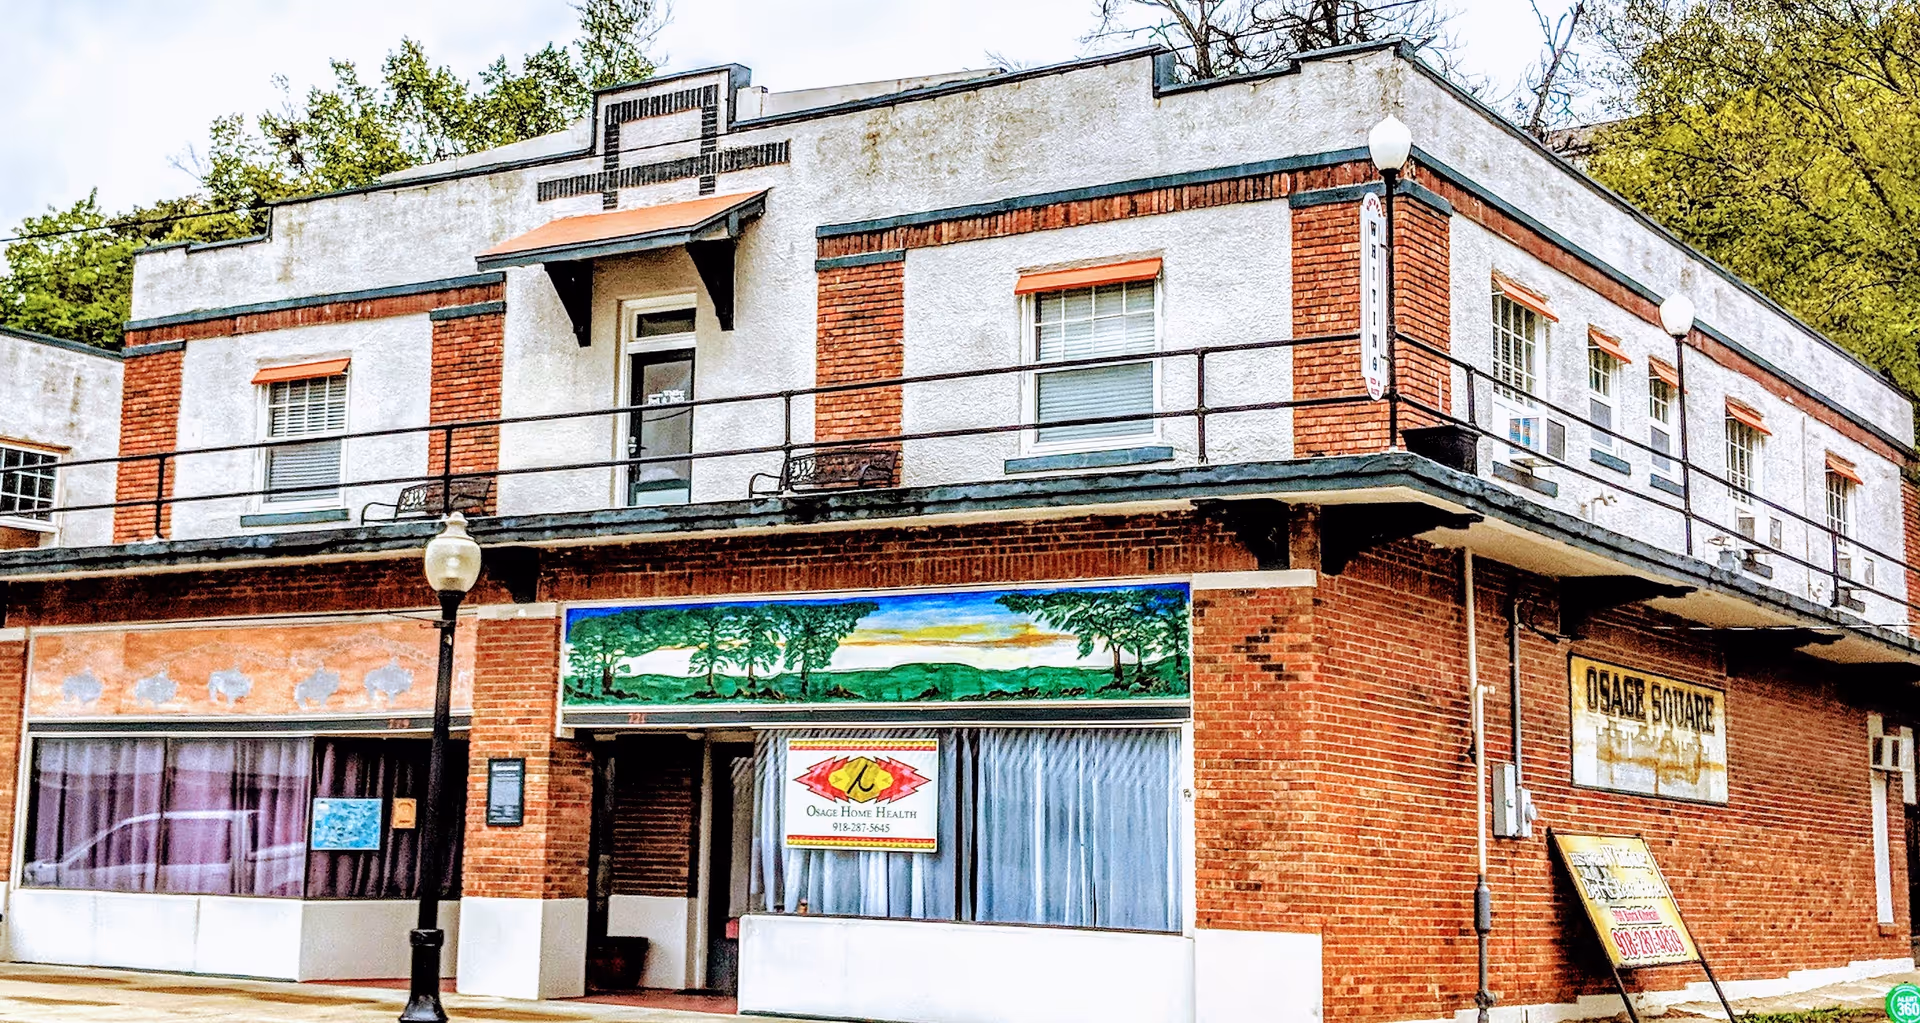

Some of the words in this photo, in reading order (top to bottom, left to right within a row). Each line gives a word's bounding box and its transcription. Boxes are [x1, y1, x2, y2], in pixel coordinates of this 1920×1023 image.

[1586, 666, 1646, 722] OSAGE
[1651, 682, 1715, 736] SQUARE
[806, 805, 838, 818] OSAGE
[841, 805, 872, 818] HOME
[875, 806, 917, 819] HEALTH
[832, 822, 890, 833] 918-287-5645
[1897, 1002, 1920, 1016] 360
